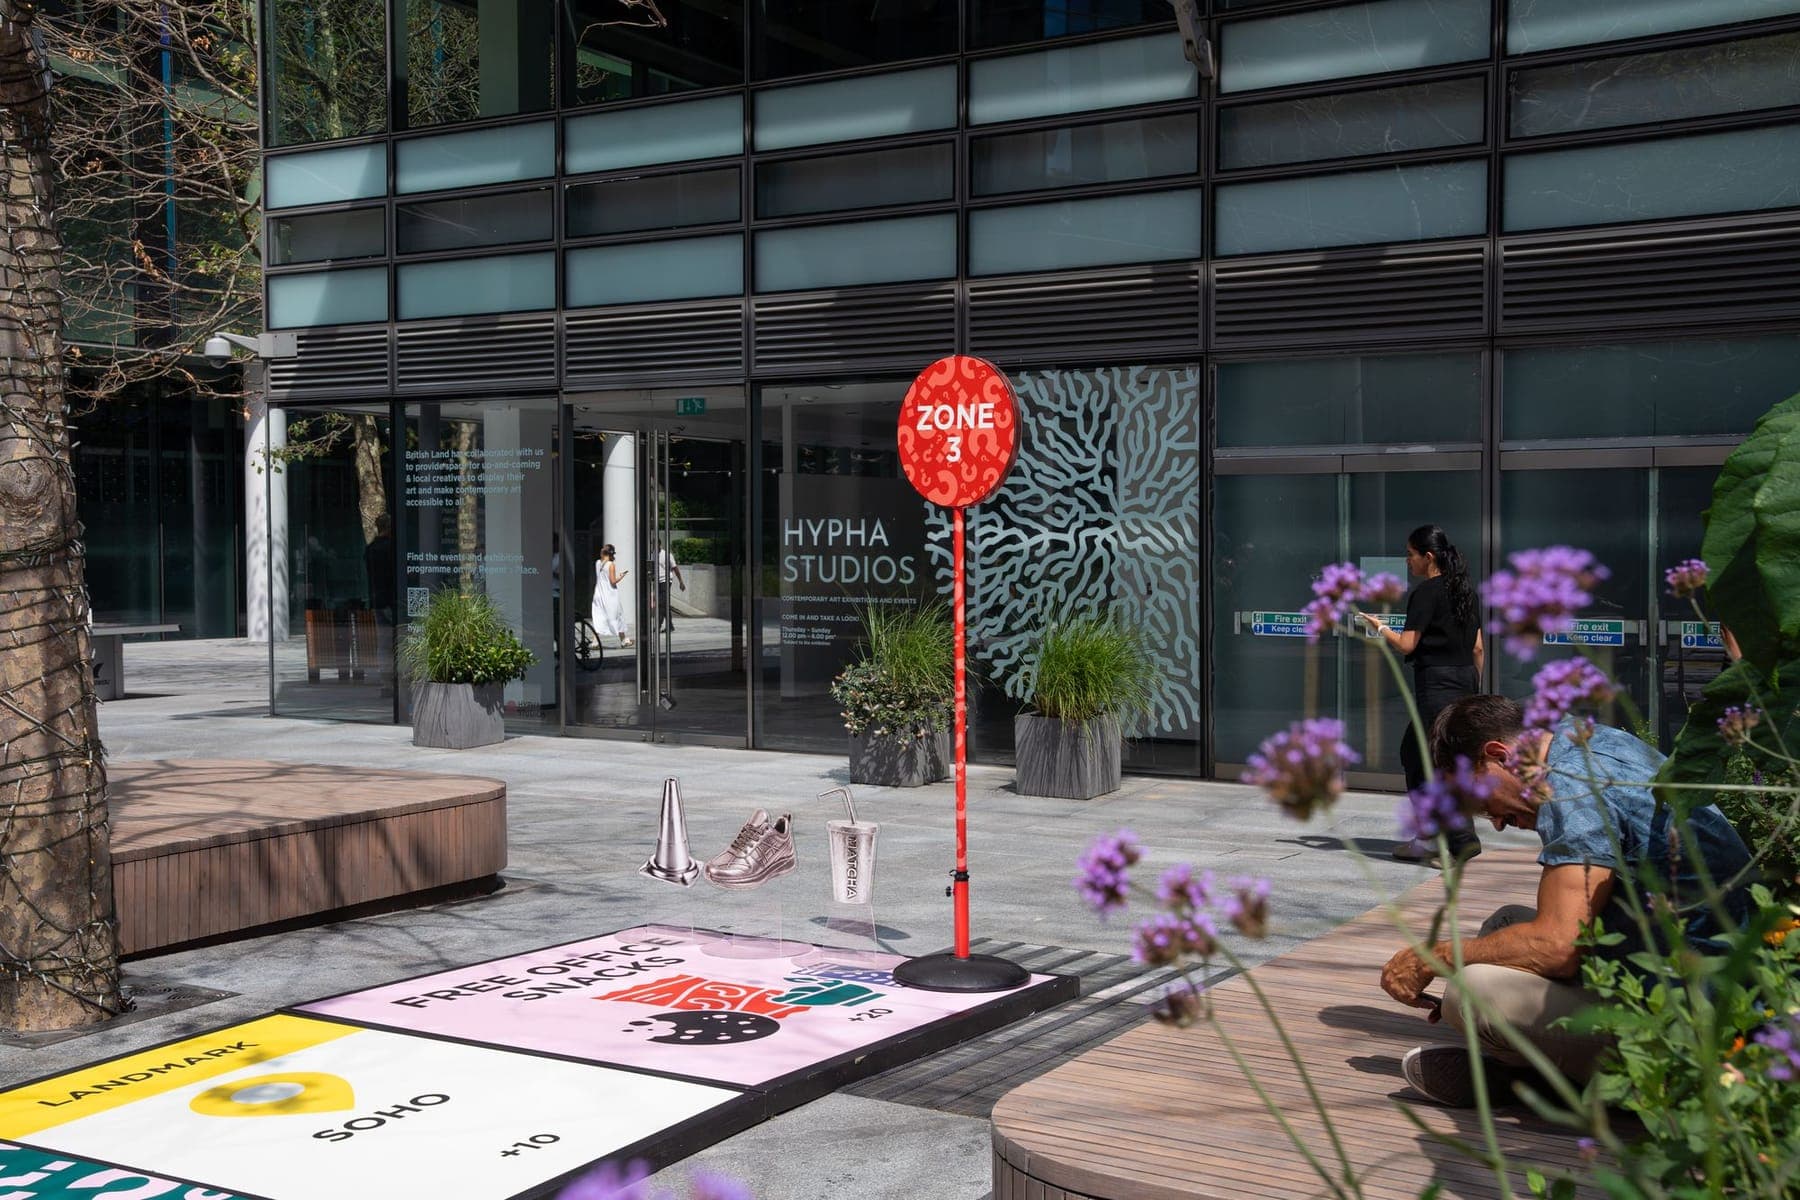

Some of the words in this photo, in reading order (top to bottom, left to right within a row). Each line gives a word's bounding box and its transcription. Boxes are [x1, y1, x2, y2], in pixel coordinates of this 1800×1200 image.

[917, 403, 994, 430] ZONE
[406, 450, 430, 460] British
[432, 450, 450, 458] Land
[466, 448, 514, 458] collaborated
[516, 447, 533, 456] with
[946, 437, 961, 462] 3
[406, 463, 414, 471] to
[416, 462, 443, 472] provide
[468, 461, 480, 470] for
[482, 460, 541, 470] up-and-coming
[406, 474, 411, 482] &
[413, 474, 430, 483] local
[432, 474, 466, 482] creatives
[478, 473, 505, 483] display
[506, 472, 525, 481] their
[418, 486, 432, 494] and
[434, 486, 454, 494] make
[456, 486, 508, 496] contemporary
[406, 498, 444, 507] accessible
[445, 498, 454, 506] to
[784, 518, 889, 546] HYPHA
[406, 552, 424, 561] Find
[426, 553, 438, 561] the
[407, 566, 452, 575] programme
[784, 555, 916, 584] STUDIOS
[842, 596, 878, 604] EXHIBITIONS
[1274, 614, 1290, 622] Fire
[782, 626, 806, 634] Thursday
[1272, 625, 1290, 634] Keep
[1570, 622, 1589, 630] Fire
[1592, 623, 1608, 631] exit
[1566, 633, 1589, 643] Keep
[1591, 634, 1612, 642] clear
[847, 836, 858, 899] MATCHA
[390, 975, 516, 1009] FREE
[526, 936, 686, 976] OFFICE
[502, 954, 686, 1002] SNACKS
[848, 1008, 894, 1022] +20
[37, 1041, 260, 1108] LANDMARK
[312, 1092, 452, 1144] SOHO
[500, 1132, 561, 1159] +10
